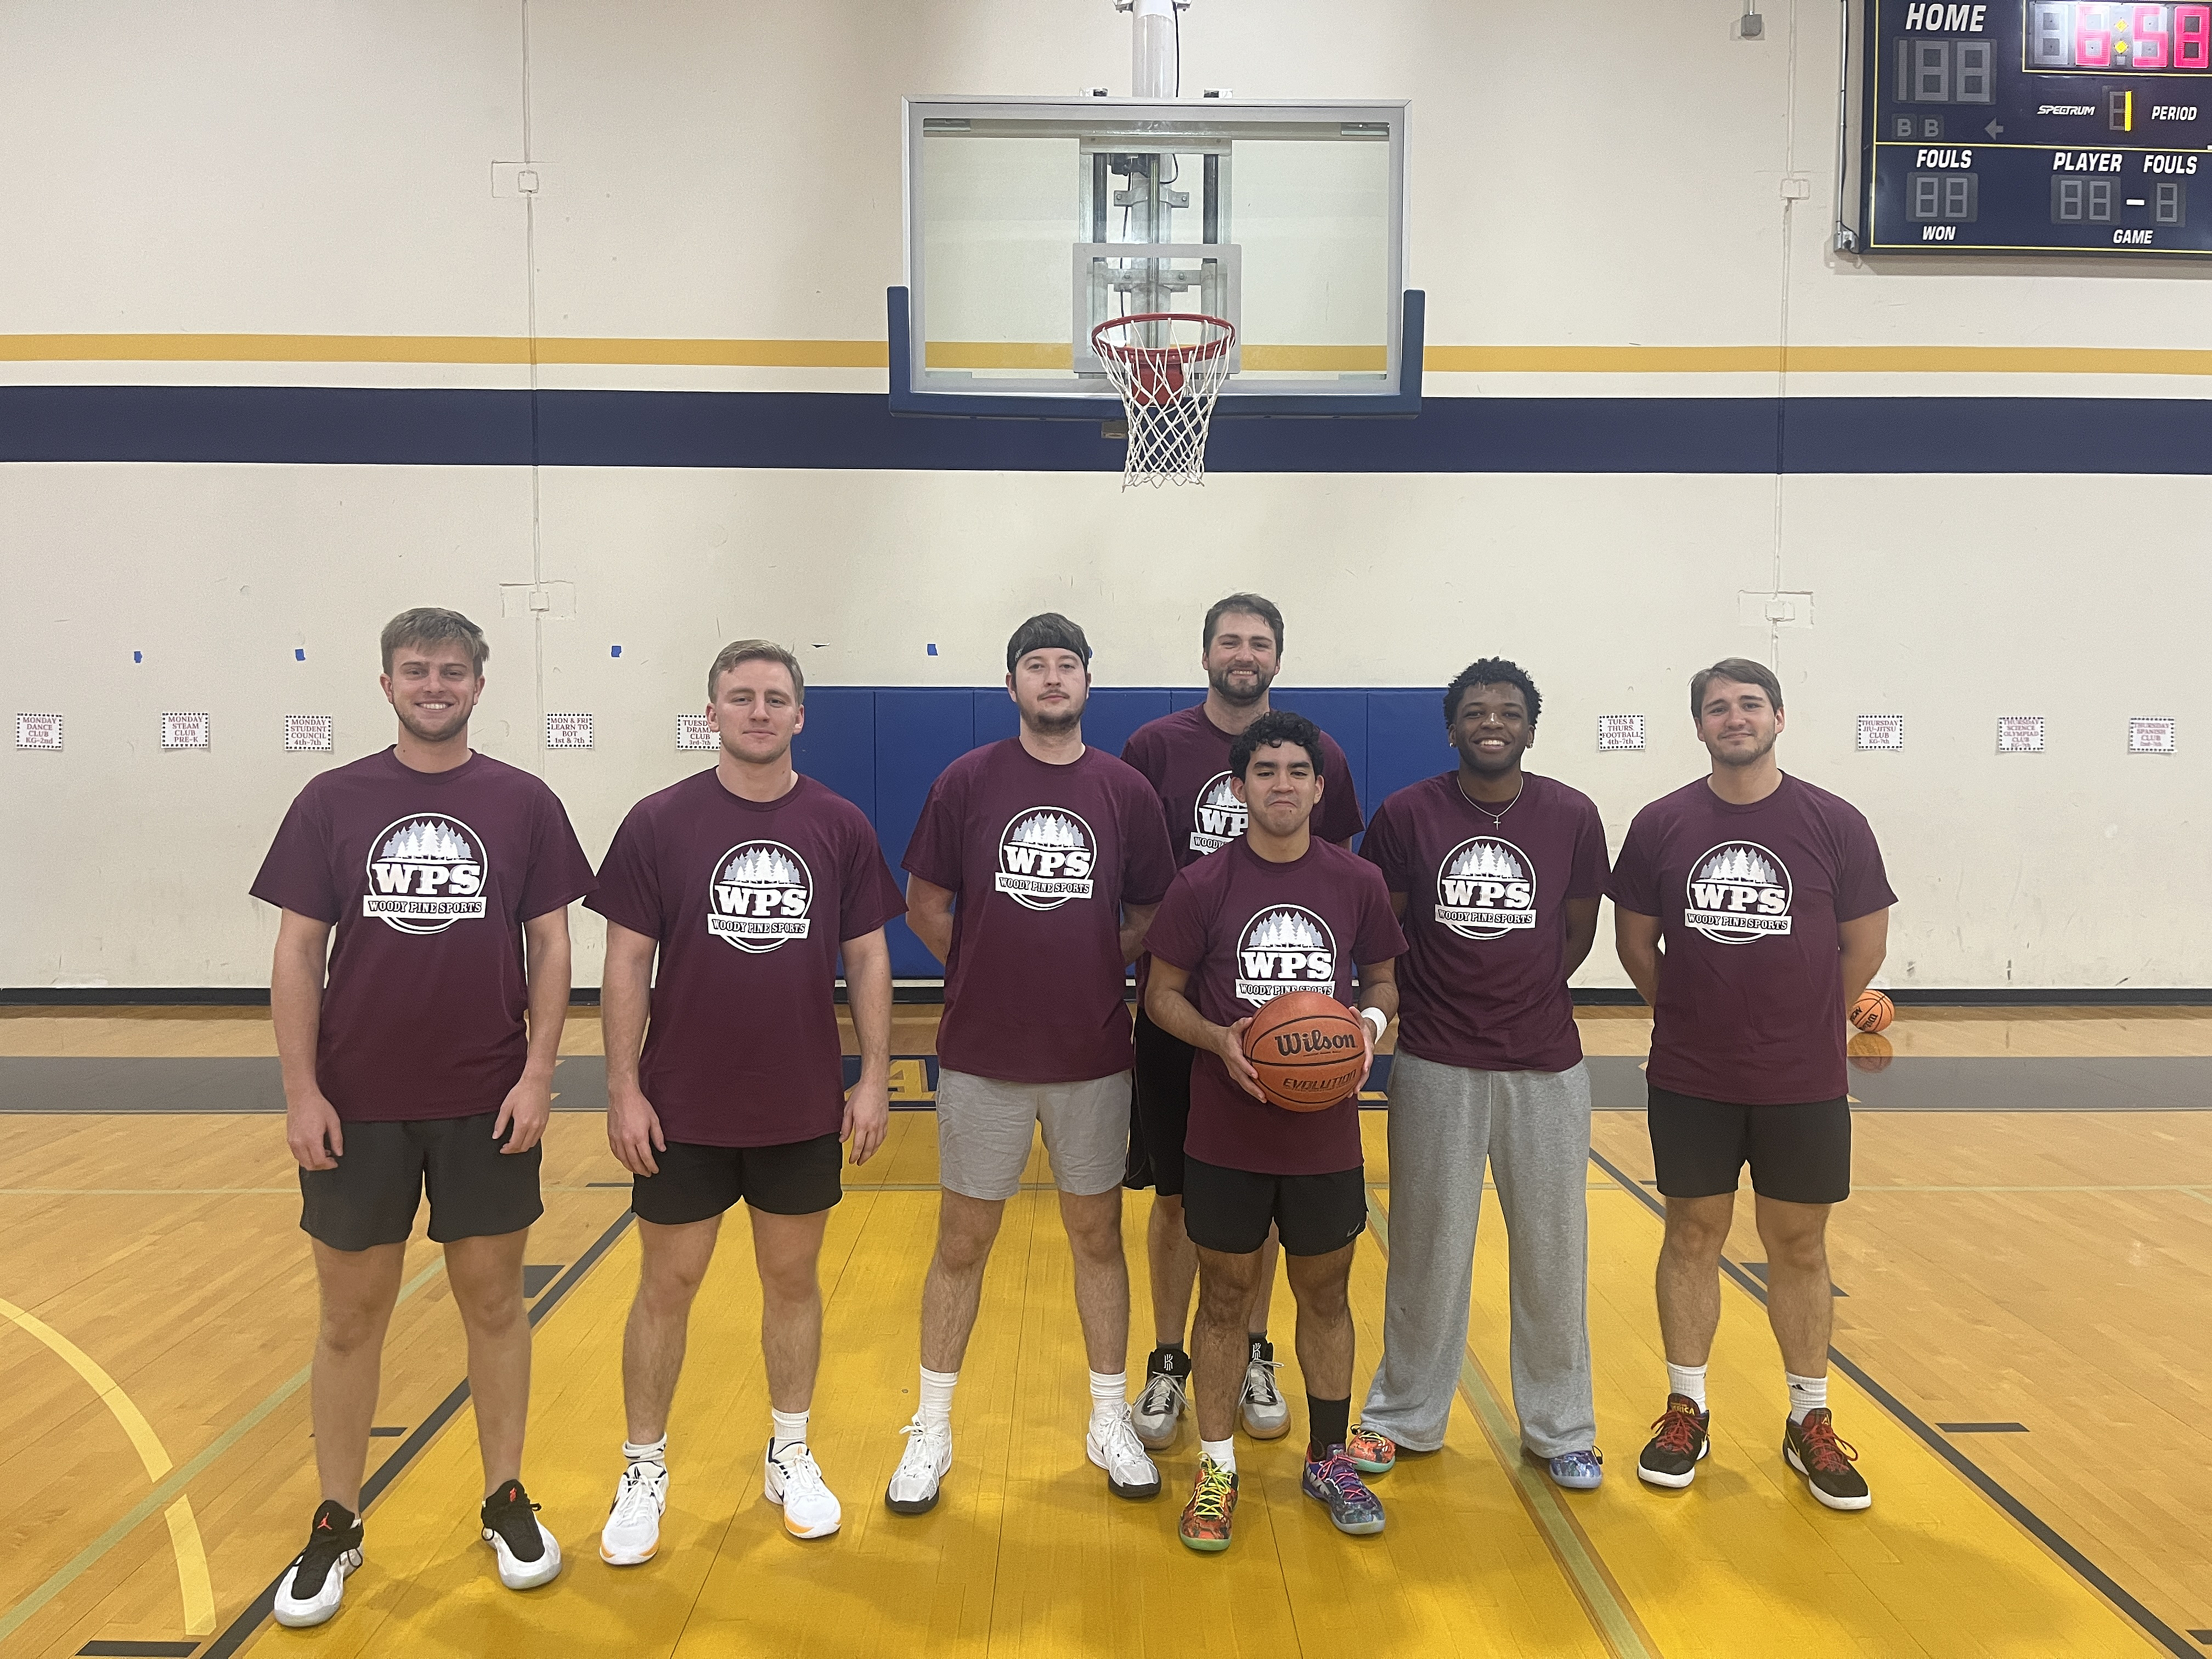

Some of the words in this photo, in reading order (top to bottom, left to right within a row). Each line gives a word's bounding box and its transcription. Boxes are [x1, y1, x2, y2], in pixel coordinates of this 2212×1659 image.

[1905, 3, 1987, 32] HOME
[2037, 105, 2095, 115] SPECTRUM
[2151, 106, 2197, 121] PERIOD
[1916, 150, 1972, 169] FOULS
[2052, 153, 2123, 173] PLAYER
[2143, 155, 2198, 175] FOULS
[1922, 226, 1956, 241] WON
[2113, 229, 2153, 245] GAME
[1199, 808, 1248, 836] WP
[1003, 845, 1091, 877] WPS
[371, 864, 481, 894] WPS
[999, 877, 1030, 890] WOODY
[1031, 882, 1053, 893] PINE
[1054, 883, 1090, 893] SPORTS
[714, 885, 808, 916] WPS
[1442, 879, 1530, 908] WPS
[1691, 883, 1785, 914] WPS
[368, 901, 408, 912] WOODY
[409, 902, 437, 913] PINE
[438, 902, 482, 913] SPORTS
[1438, 909, 1470, 921] WOODY
[1471, 912, 1493, 922] PINE
[1494, 913, 1532, 923] SPORTS
[712, 919, 747, 932] WOODY
[748, 922, 770, 933] PINE
[771, 923, 805, 933] SPORTS
[1687, 913, 1720, 925] WOODY
[1722, 917, 1746, 927] PINE
[1747, 919, 1787, 929] SPORTS
[1241, 951, 1331, 979] WPS
[1239, 984, 1272, 995] WOODY
[1274, 1030, 1356, 1056] Wilson
[1283, 1069, 1357, 1090] EVOLUTION
